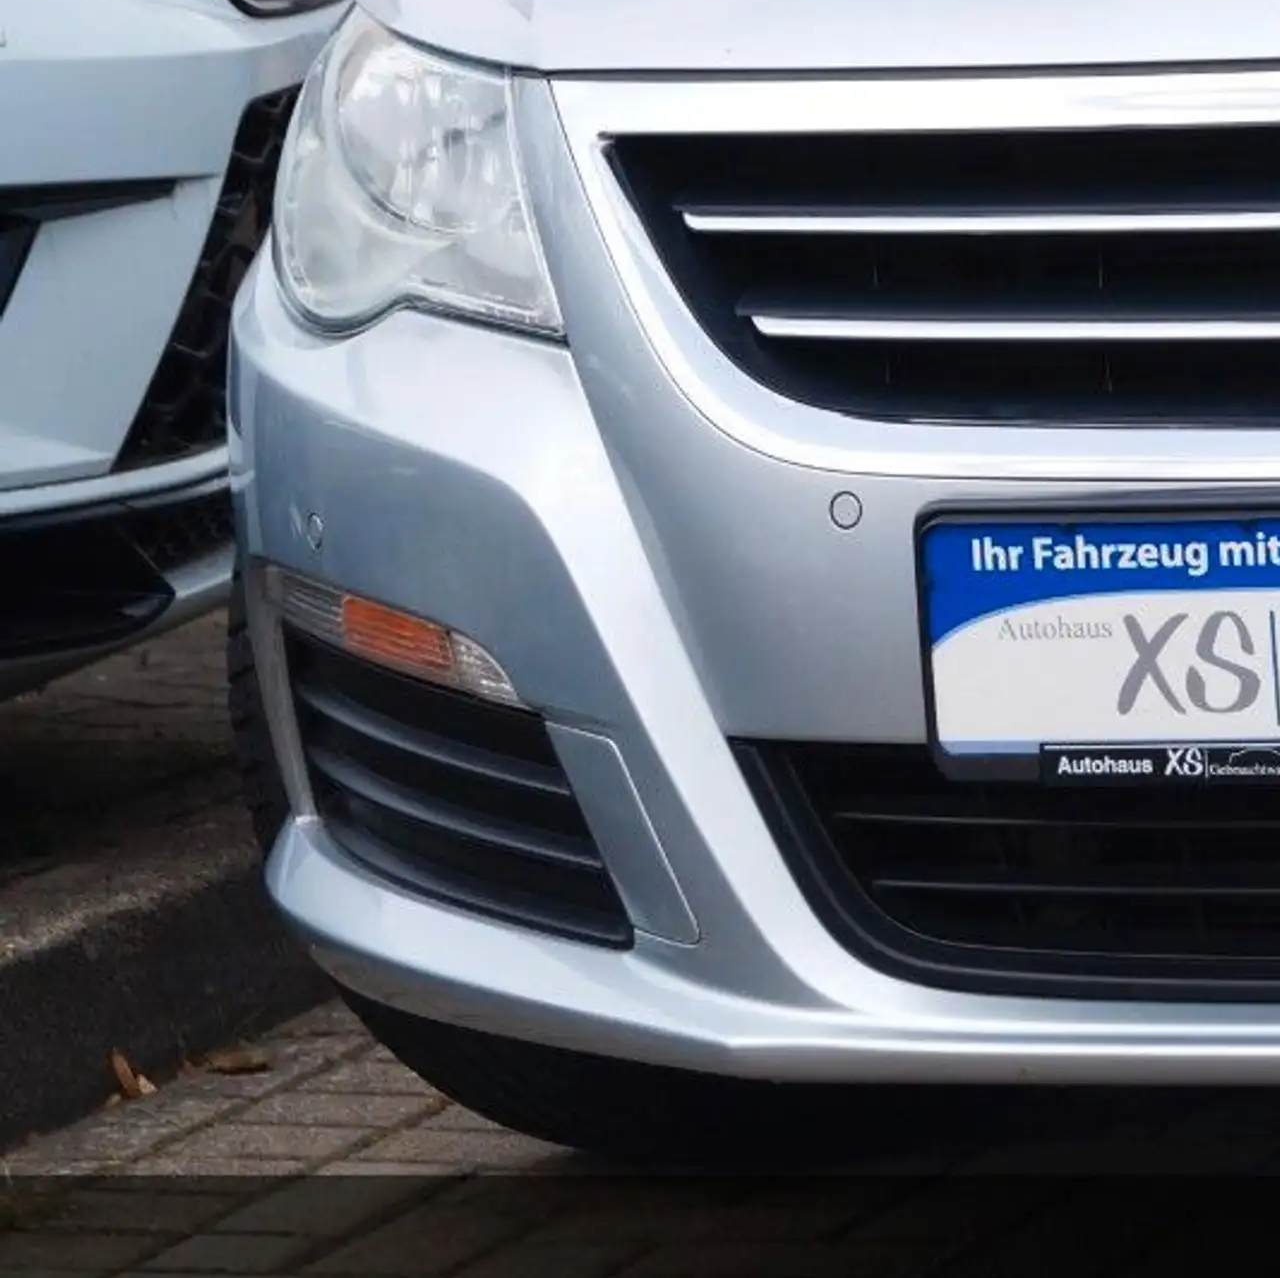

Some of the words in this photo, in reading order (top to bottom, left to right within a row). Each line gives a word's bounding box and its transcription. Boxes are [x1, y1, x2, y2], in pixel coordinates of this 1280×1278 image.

[971, 537, 1023, 572] Ihr
[1032, 535, 1209, 576] Fahrzeug
[998, 619, 1113, 642] Autohaus
[1116, 611, 1261, 715] XS
[1057, 755, 1153, 775] Autohaus
[1164, 748, 1203, 776] XS
